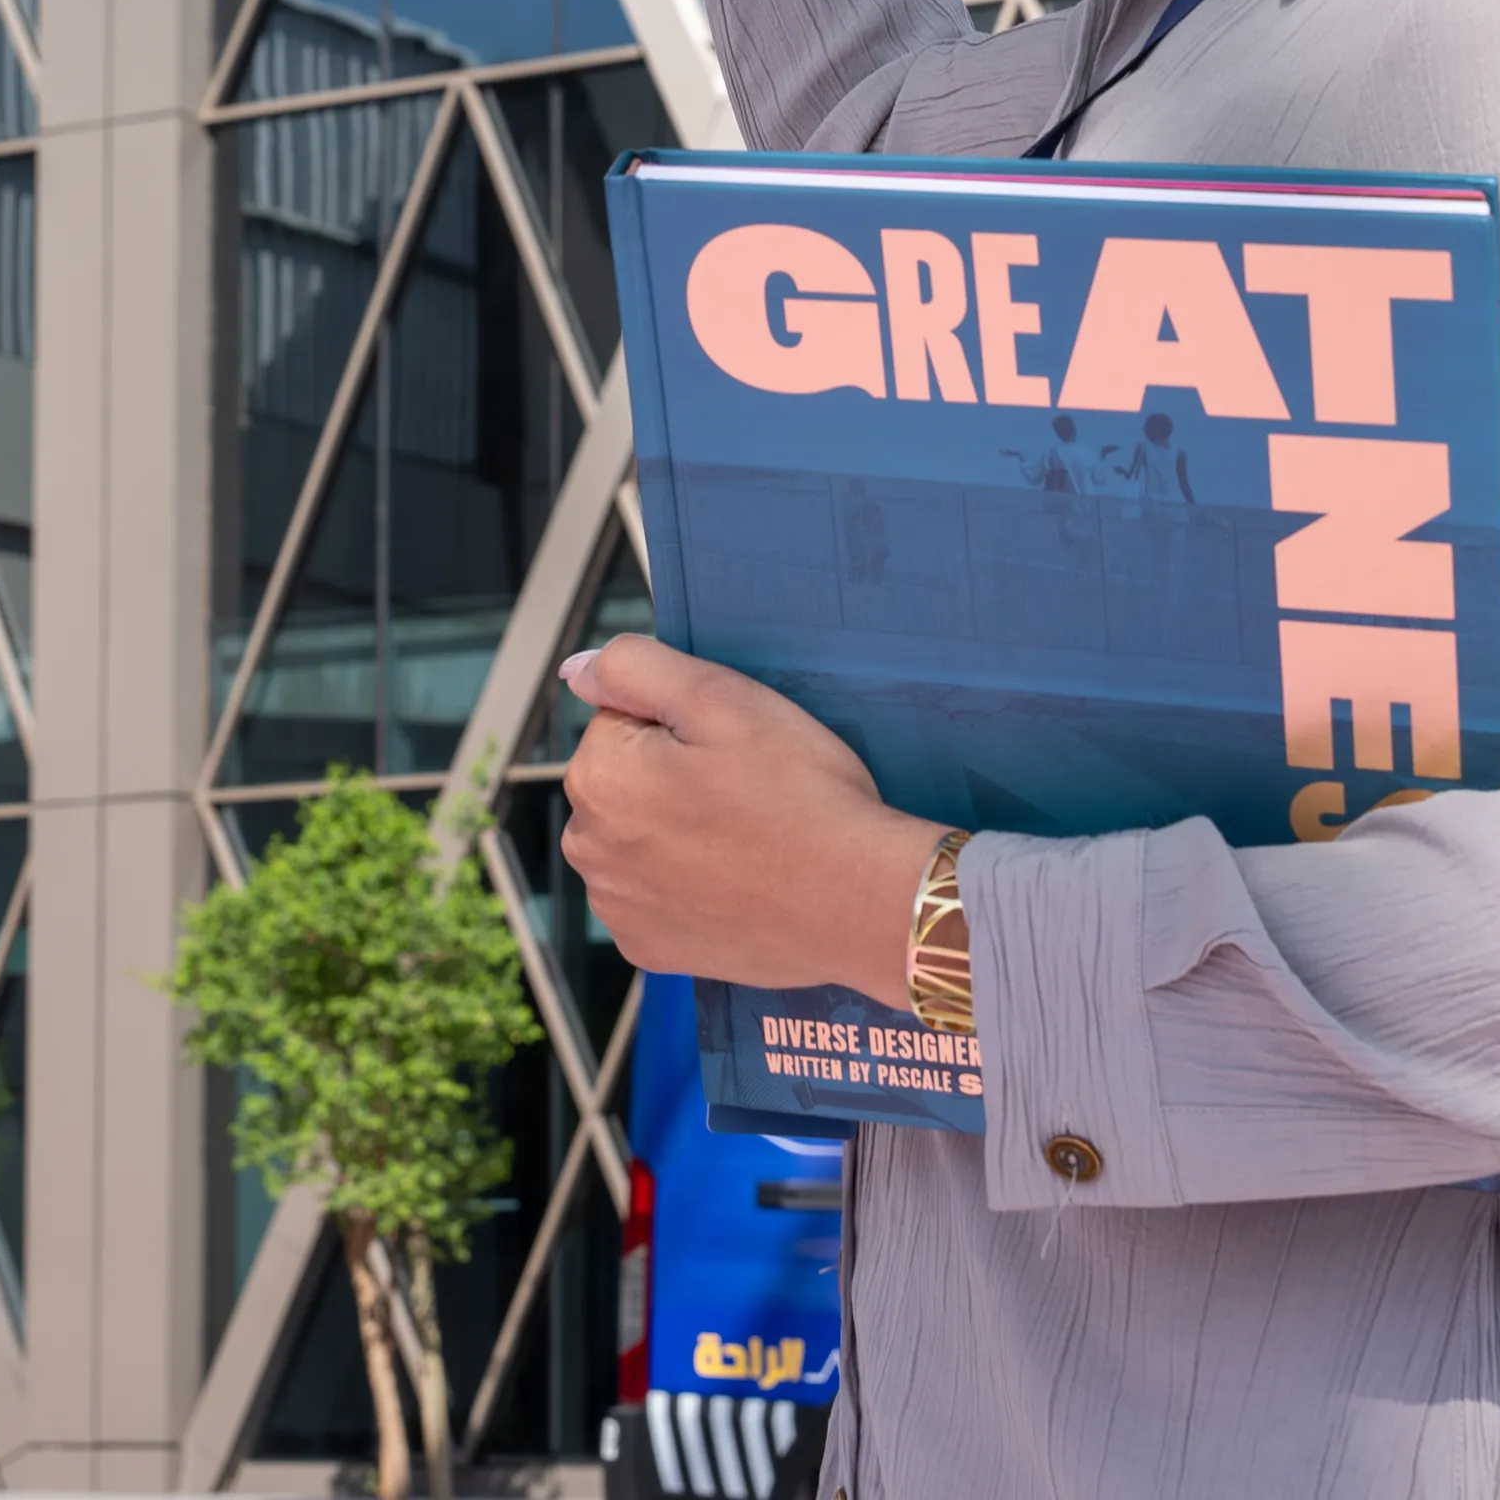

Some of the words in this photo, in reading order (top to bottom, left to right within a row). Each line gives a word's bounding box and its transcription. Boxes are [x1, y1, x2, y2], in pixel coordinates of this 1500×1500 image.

[687, 223, 1454, 425] GREAT
[762, 1015, 860, 1054] DIVERSE
[765, 1051, 842, 1081] WRITTEN
[849, 1061, 871, 1084] BY
[877, 1064, 953, 1093] PASCALE
[693, 1331, 805, 1390] الراحة
